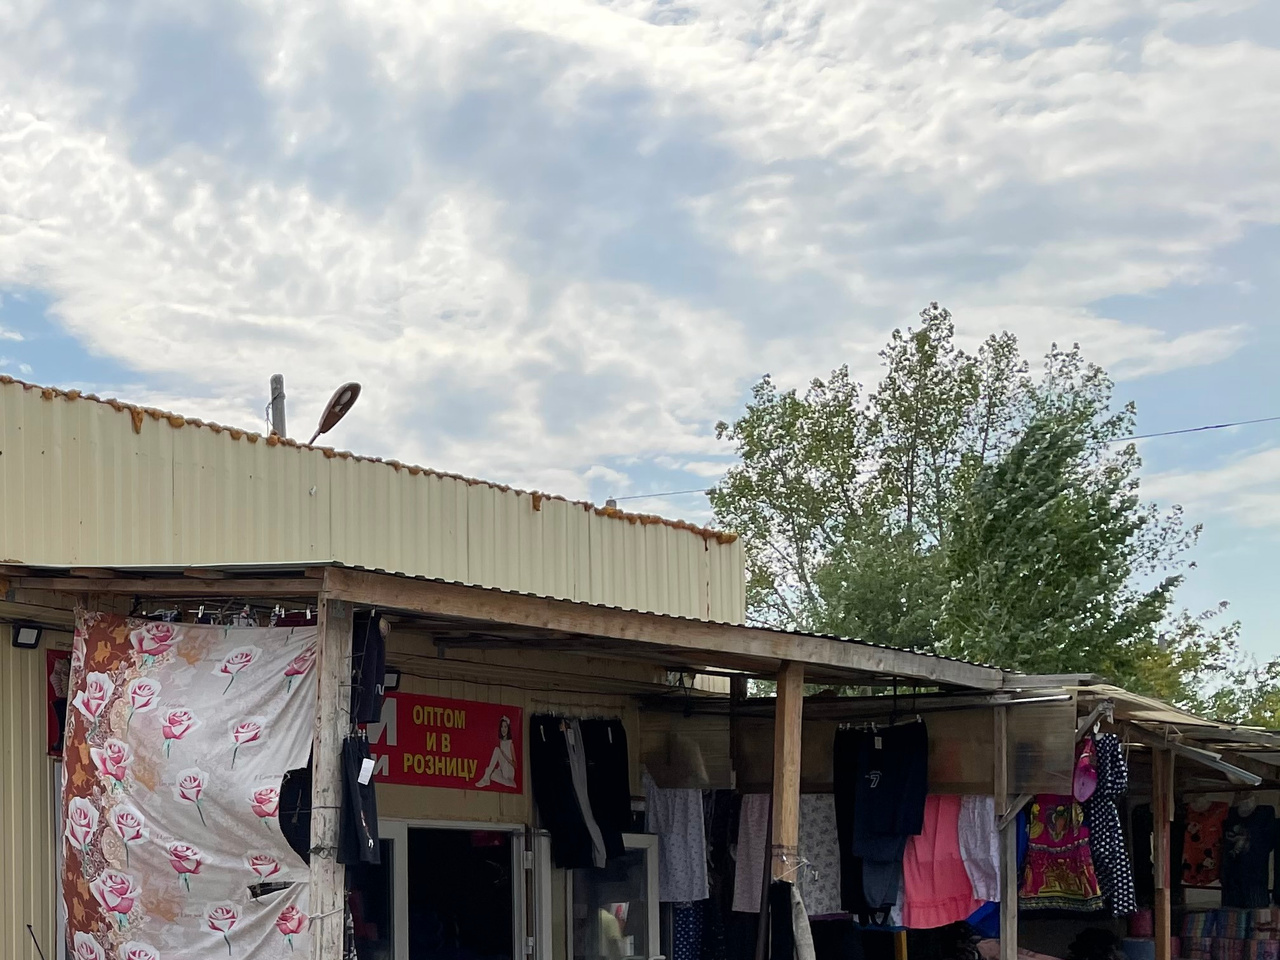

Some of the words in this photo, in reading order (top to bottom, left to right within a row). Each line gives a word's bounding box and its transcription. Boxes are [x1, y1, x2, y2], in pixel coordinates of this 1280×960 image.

[413, 705, 466, 729] ОПТОМ
[426, 732, 437, 751] И
[441, 733, 451, 753] В
[403, 753, 478, 781] РОЗНИЦУ
